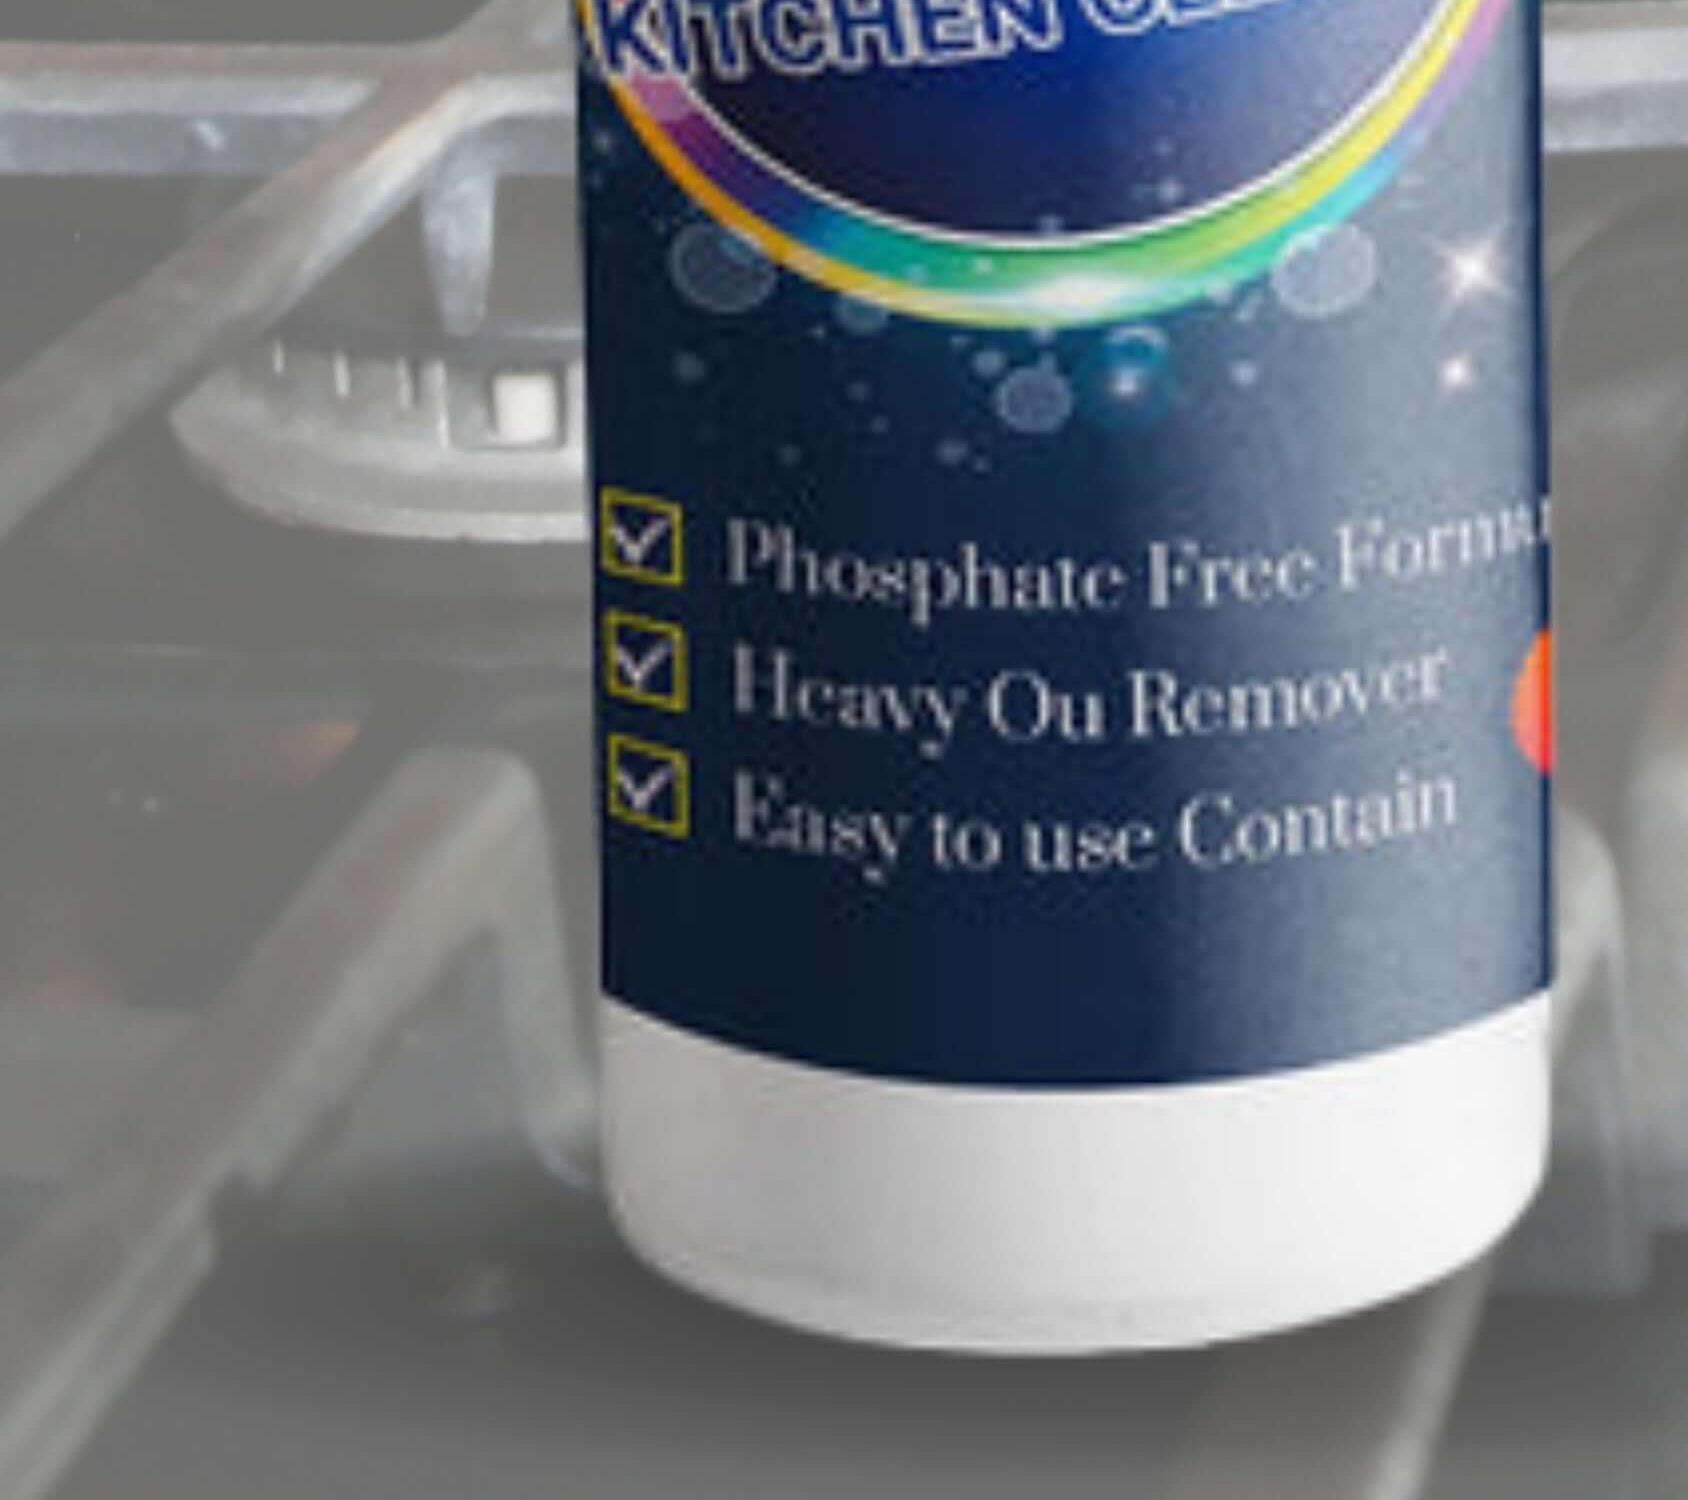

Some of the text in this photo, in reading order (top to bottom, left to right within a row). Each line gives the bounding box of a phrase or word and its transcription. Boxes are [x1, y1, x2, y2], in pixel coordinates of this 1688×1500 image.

[725, 519, 1126, 627] Phosphate
[1149, 537, 1316, 608] Free
[731, 644, 1451, 759] Heavy Ou Remover
[732, 770, 1459, 885] Easy to use Contain
